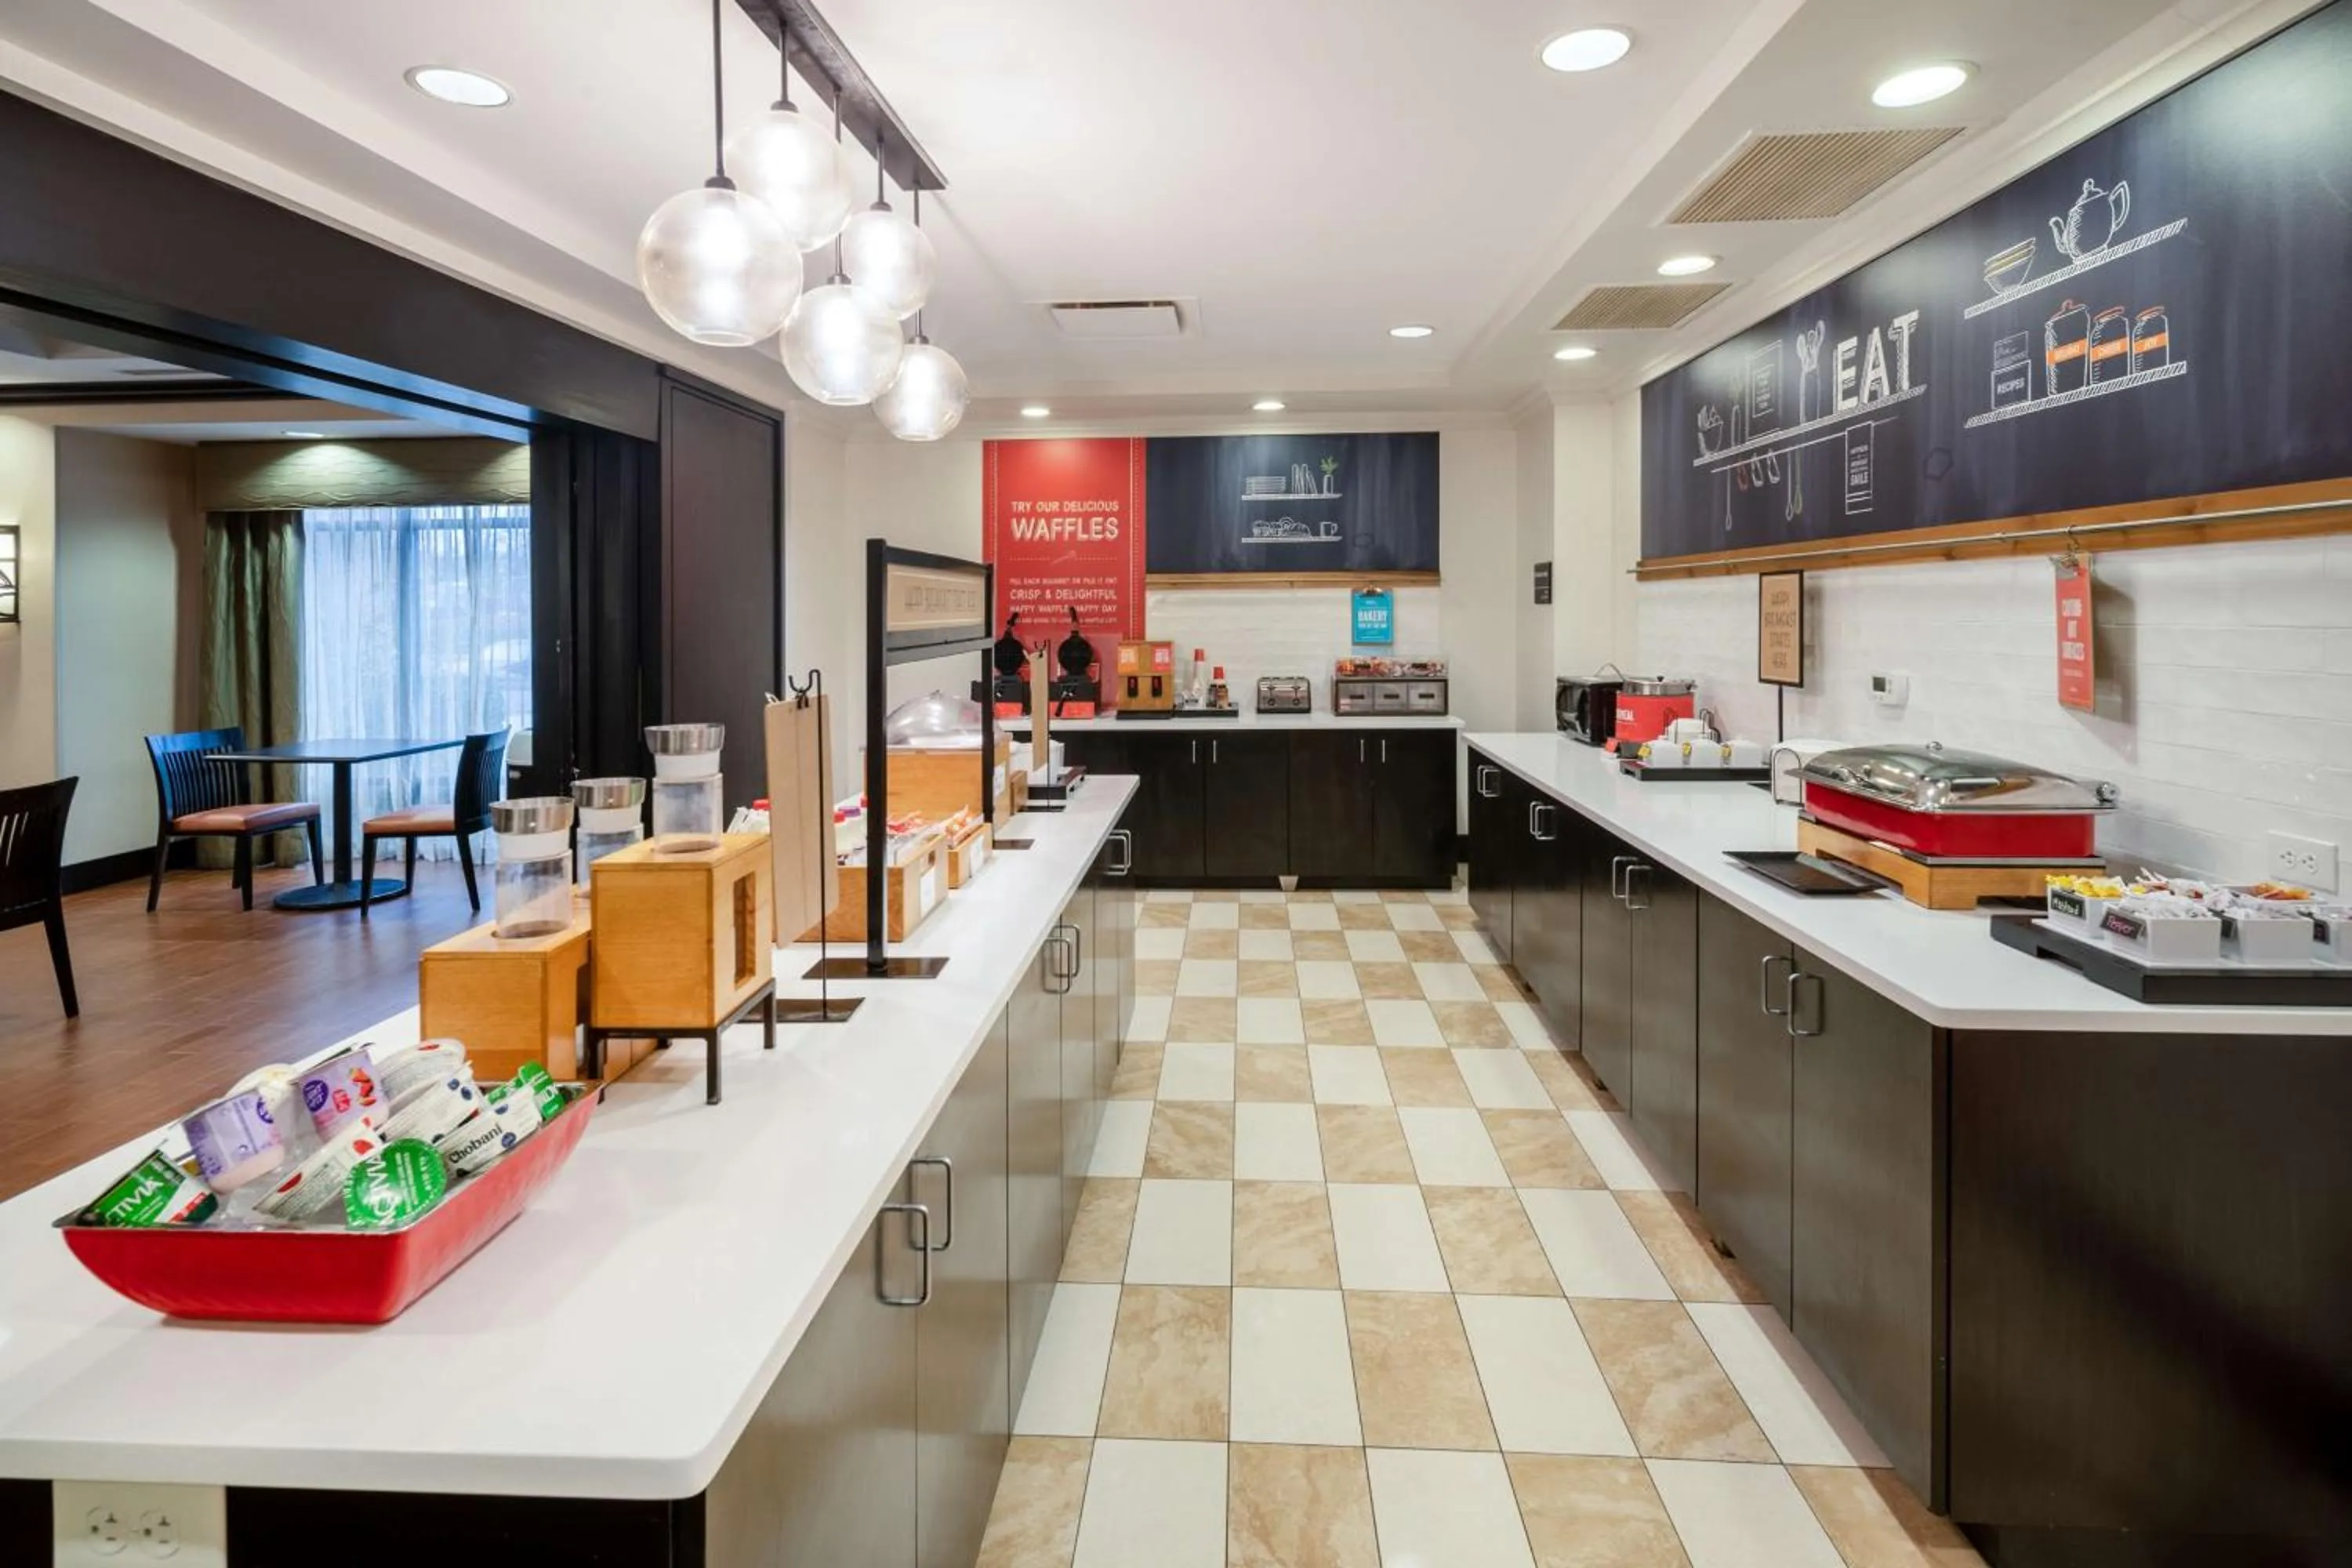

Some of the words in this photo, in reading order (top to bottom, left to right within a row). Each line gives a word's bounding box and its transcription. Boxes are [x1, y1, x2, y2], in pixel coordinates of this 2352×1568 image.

[1833, 310, 1919, 414] EAT
[1011, 501, 1032, 512] TRY
[1036, 501, 1058, 512] OUR
[1063, 501, 1119, 512] DELICIOUS
[1011, 517, 1119, 542] WAFFLES
[1010, 589, 1041, 600] CRISP
[1045, 589, 1051, 600] &
[1055, 589, 1117, 600] DELIGHTFUL
[1102, 604, 1117, 613] DAY
[449, 1123, 503, 1164] Chobani
